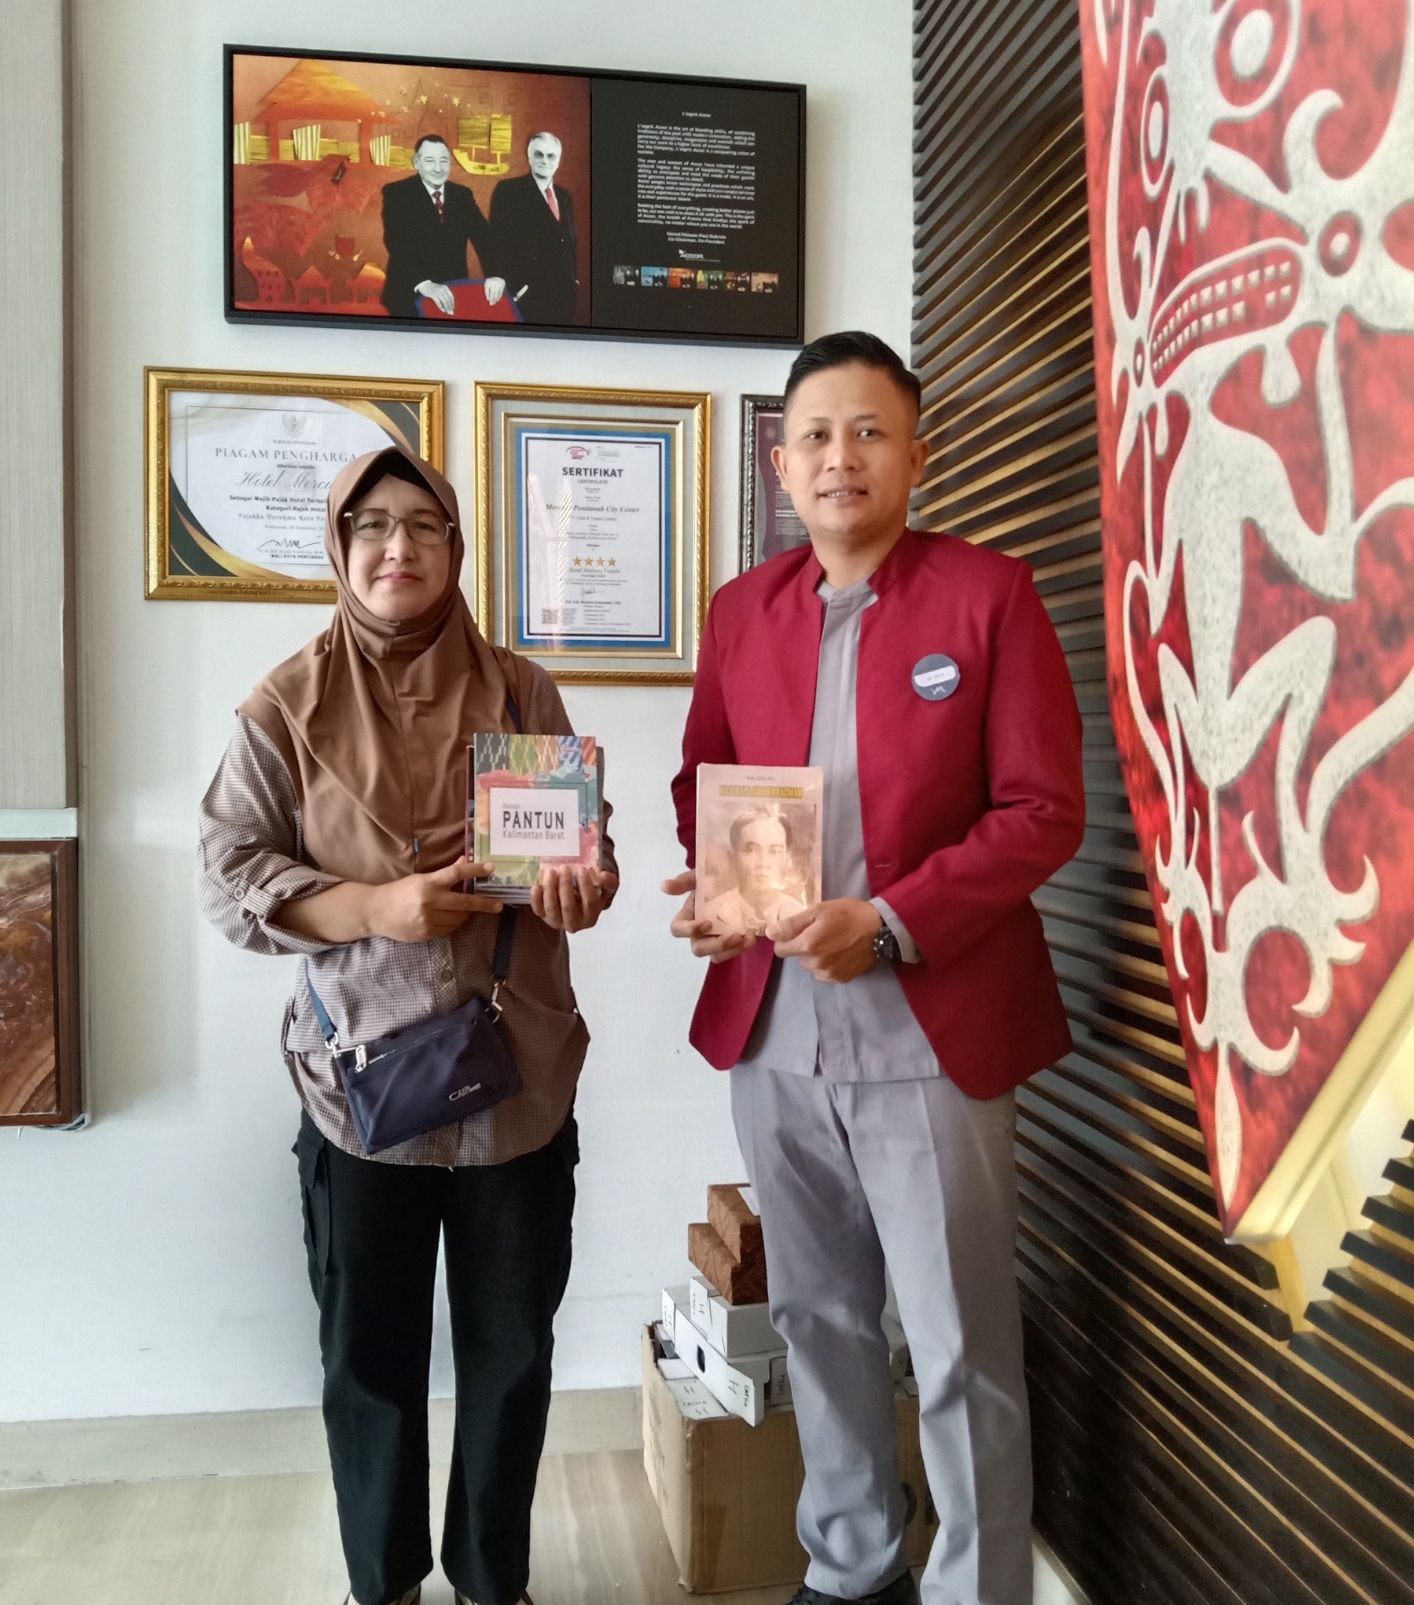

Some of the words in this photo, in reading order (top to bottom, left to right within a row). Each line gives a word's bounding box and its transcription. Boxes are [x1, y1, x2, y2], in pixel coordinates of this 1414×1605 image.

[215, 447, 269, 459] PIAGAM
[562, 466, 624, 478] SERTIFIKAT
[236, 470, 286, 488] Hotel
[503, 810, 564, 829] PANTUN
[503, 830, 543, 840] Kalimantan
[545, 831, 564, 840] Barat
